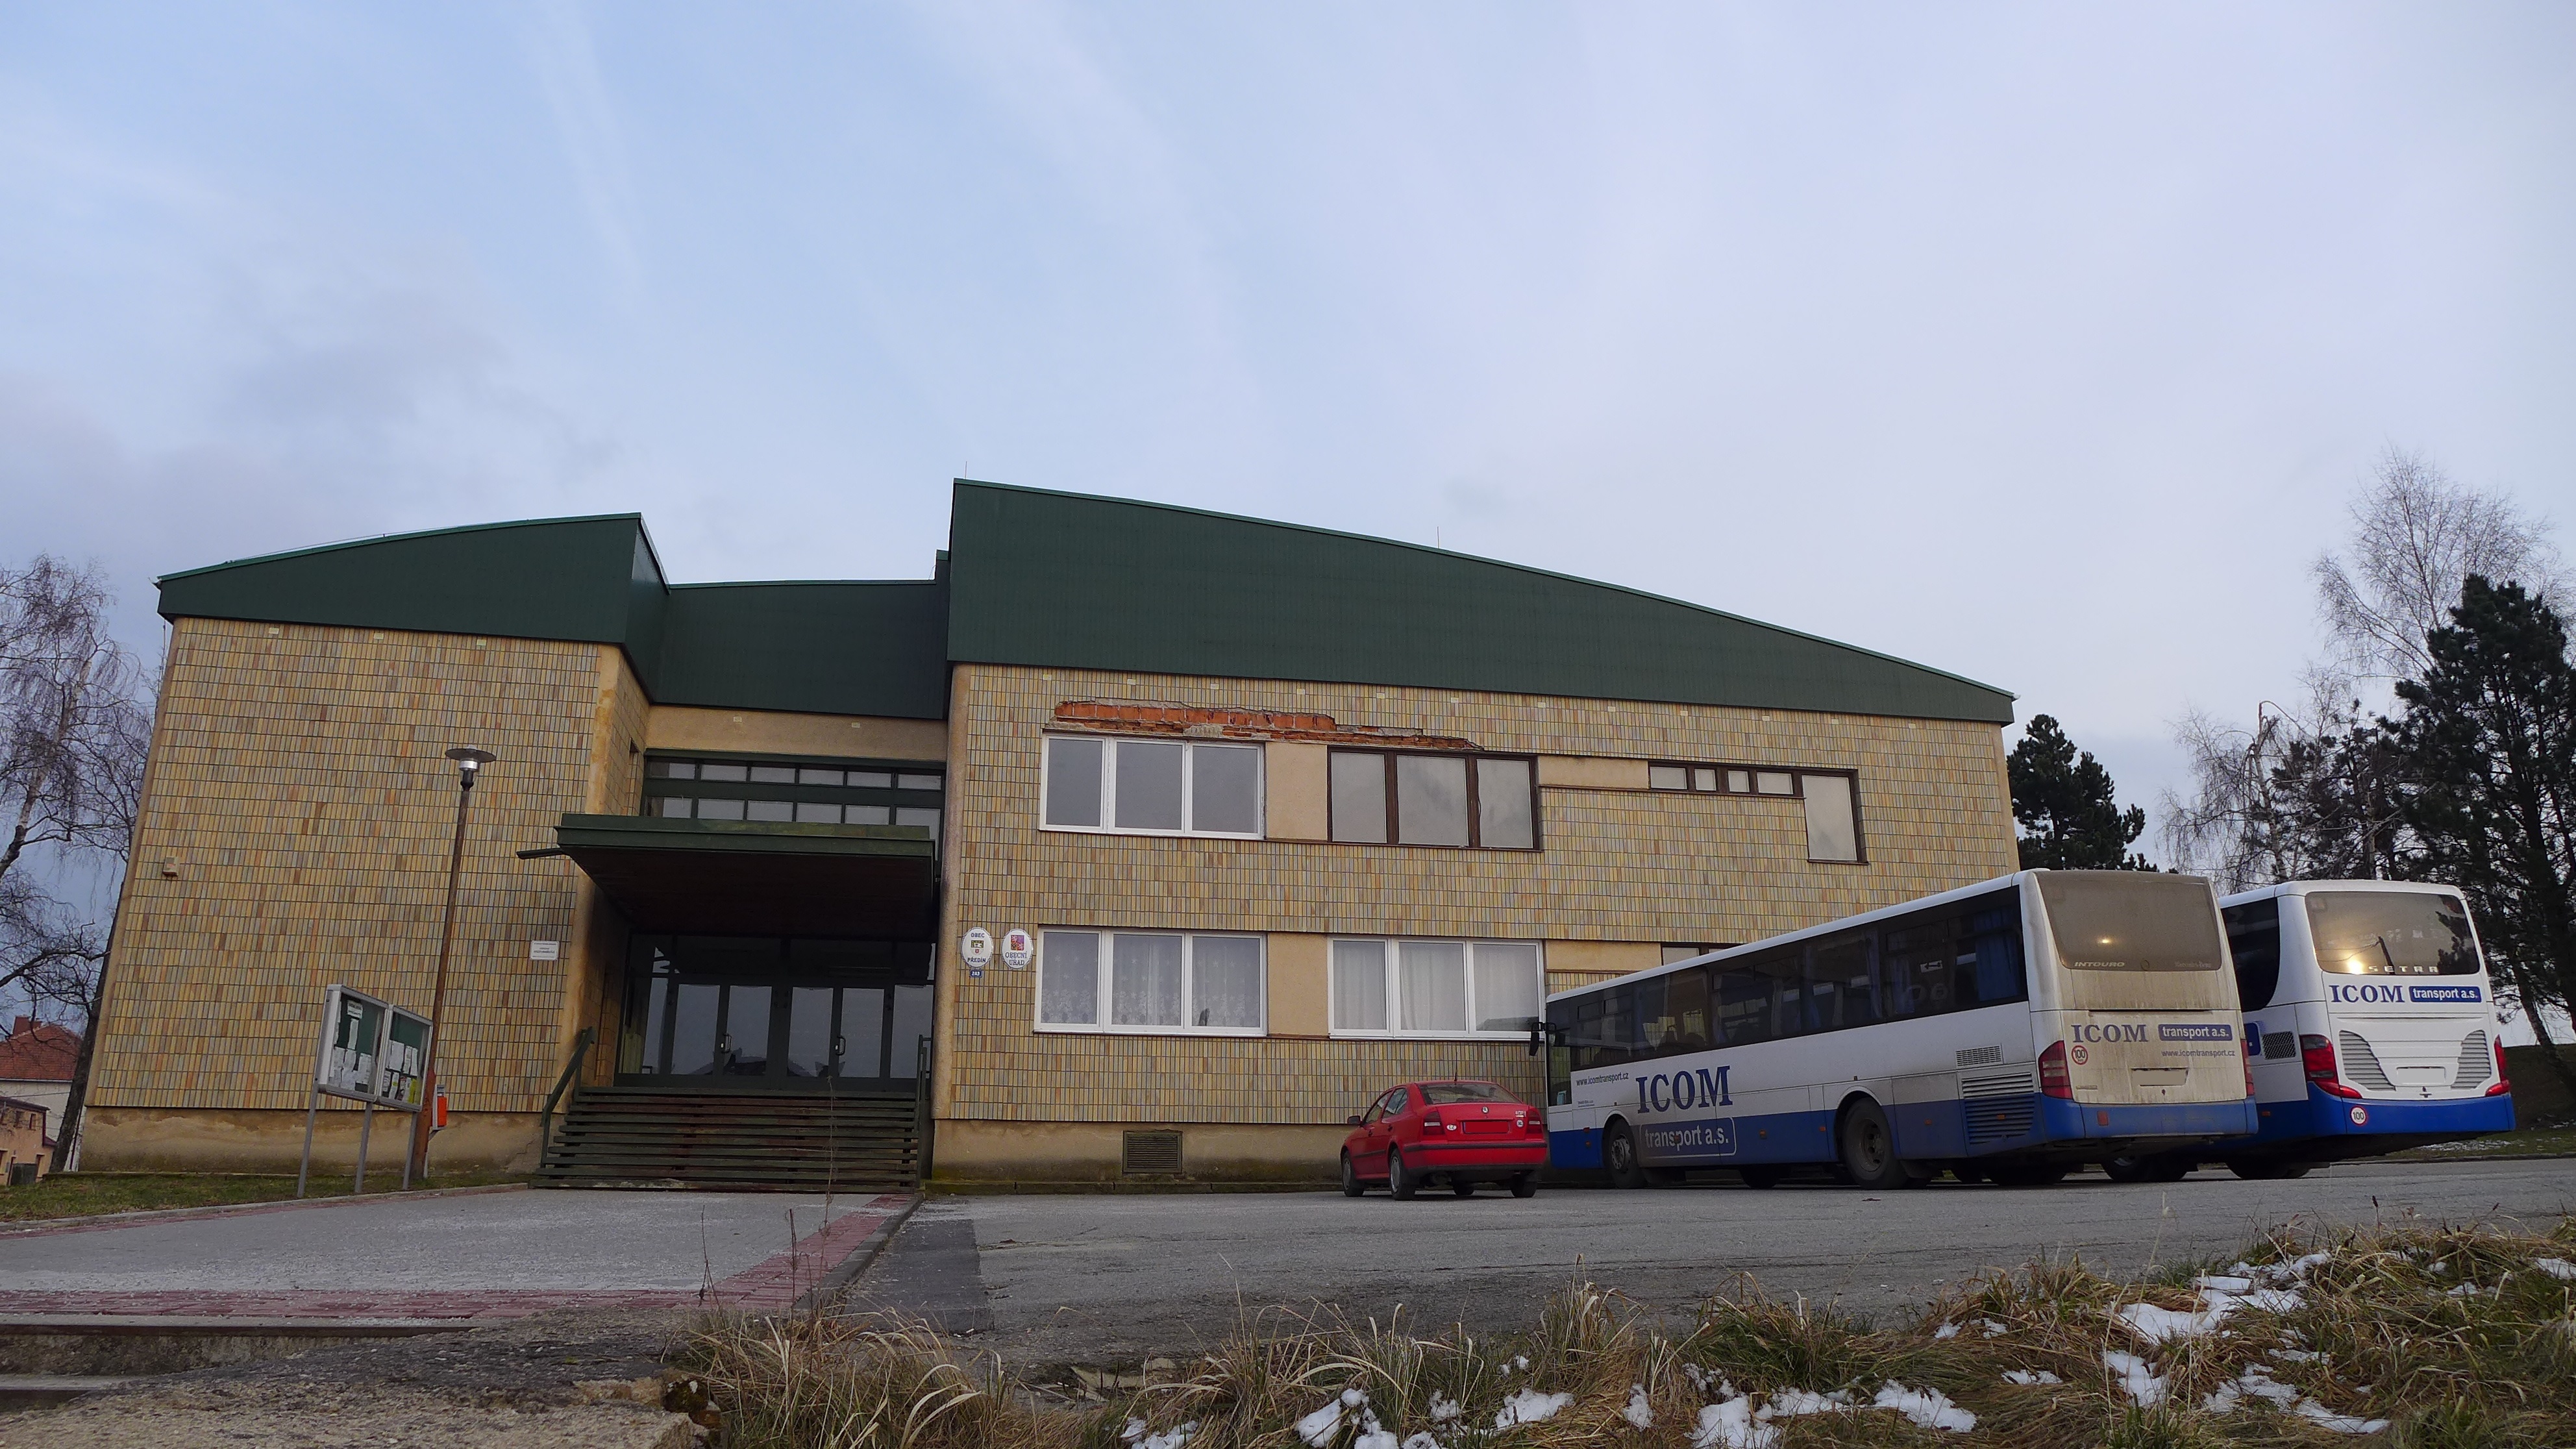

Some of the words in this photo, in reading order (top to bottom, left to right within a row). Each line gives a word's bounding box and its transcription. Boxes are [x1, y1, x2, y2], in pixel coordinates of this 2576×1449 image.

[2329, 985, 2405, 1003] ICOM
[2412, 987, 2460, 1001] transport
[2071, 1024, 2148, 1043] ICOM
[2162, 1026, 2210, 1039] transport
[2212, 1027, 2229, 1037] a.s.
[2161, 1050, 2235, 1058] www.icomtransport.cz
[1576, 1072, 1629, 1086] www.icomtransport.cz
[1635, 1065, 1733, 1114] ICOM
[2353, 1111, 2364, 1120] 100
[1645, 1125, 1702, 1151] transport
[1705, 1126, 1729, 1145] a.s.
